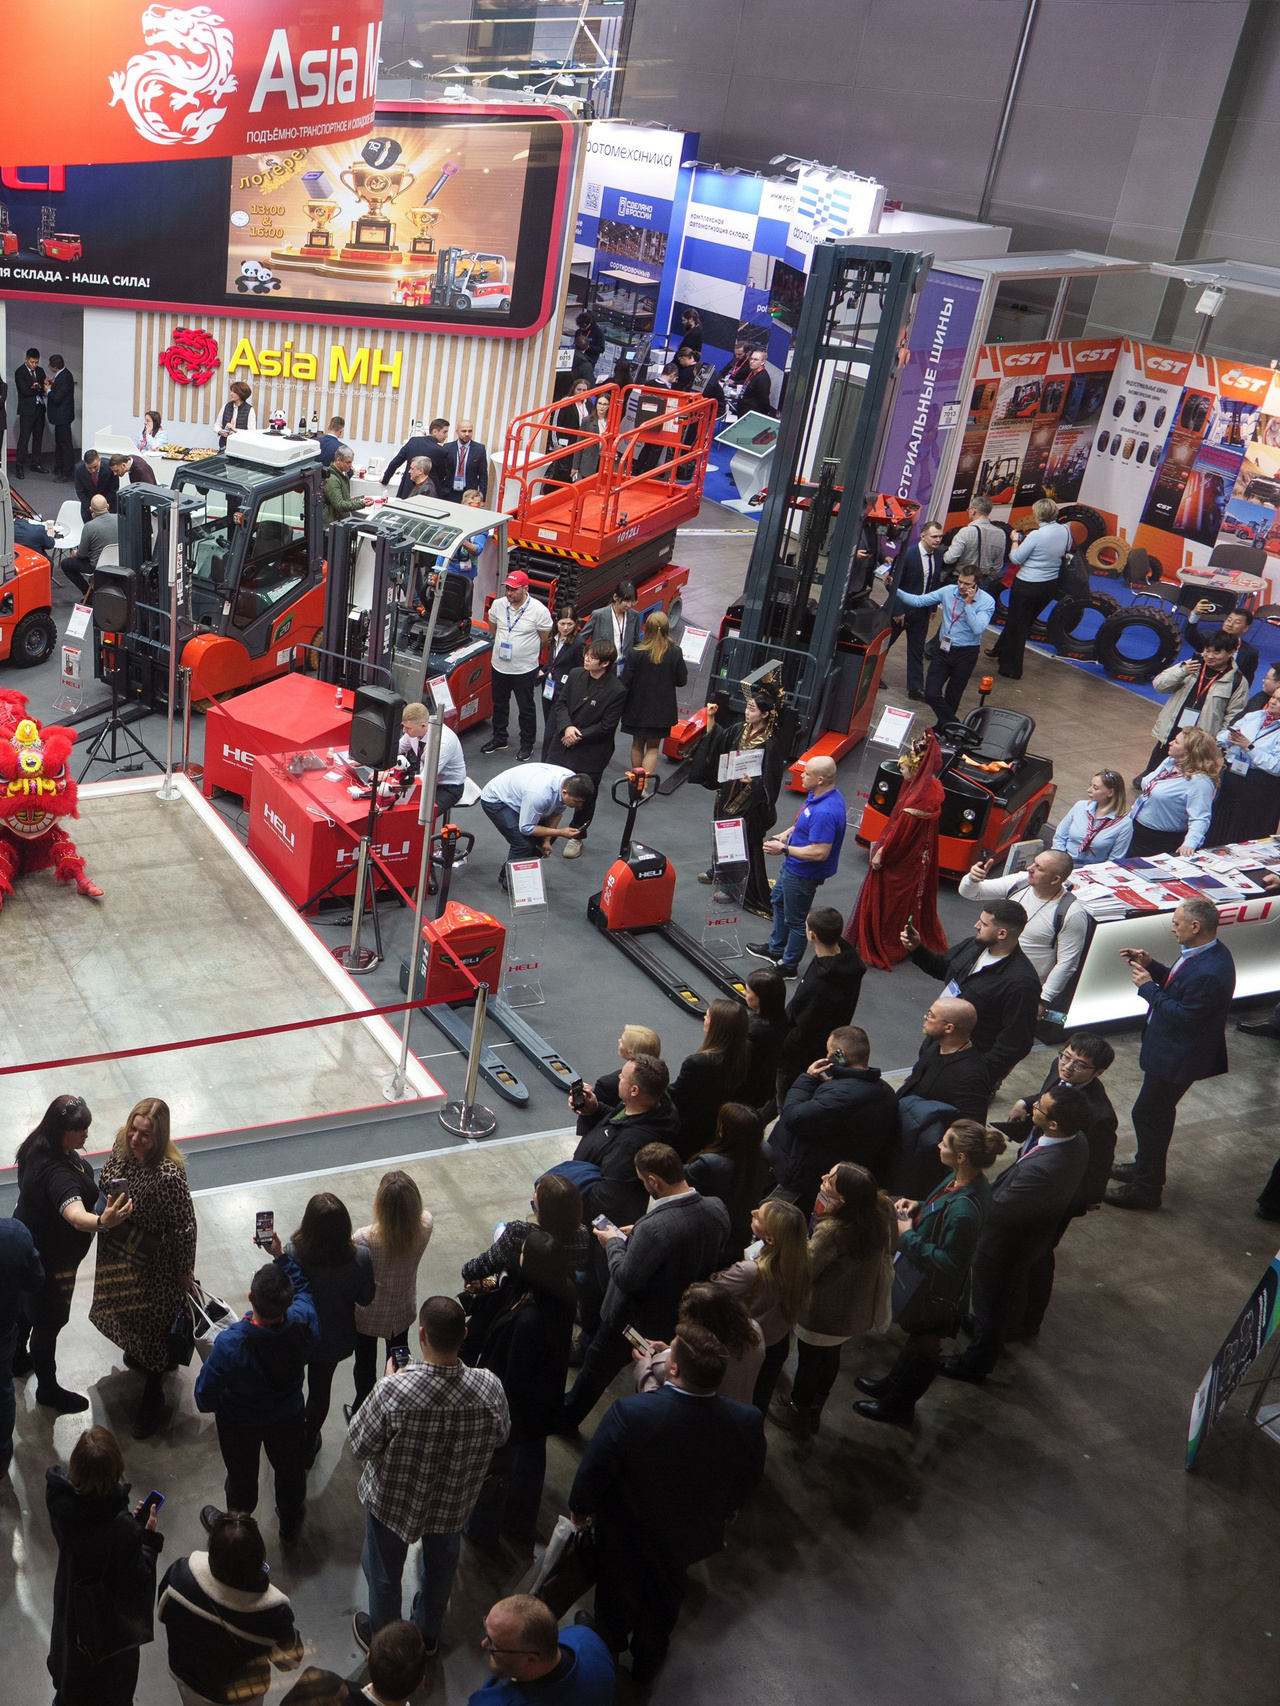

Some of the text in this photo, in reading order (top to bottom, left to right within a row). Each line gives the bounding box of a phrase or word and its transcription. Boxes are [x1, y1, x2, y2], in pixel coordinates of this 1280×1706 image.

[248, 26, 358, 113] Asia
[250, 204, 286, 216] 13:00
[262, 216, 272, 226] &
[249, 227, 285, 239] 16:00
[13, 269, 63, 282] СКЛАДА
[72, 273, 110, 285] НАША
[112, 275, 151, 288] СИЛА!
[928, 296, 955, 365] ШИНЫ
[226, 337, 403, 389] Asia MH
[1004, 351, 1046, 367] CST
[1075, 348, 1116, 363] CST
[1146, 356, 1189, 374] CST
[1221, 371, 1268, 393] CST
[176, 568, 184, 606] HELI
[382, 612, 392, 655] HELI
[223, 743, 254, 767] HE
[264, 803, 295, 848] HELI
[638, 868, 663, 880] HELI
[1217, 901, 1273, 927] ELI
